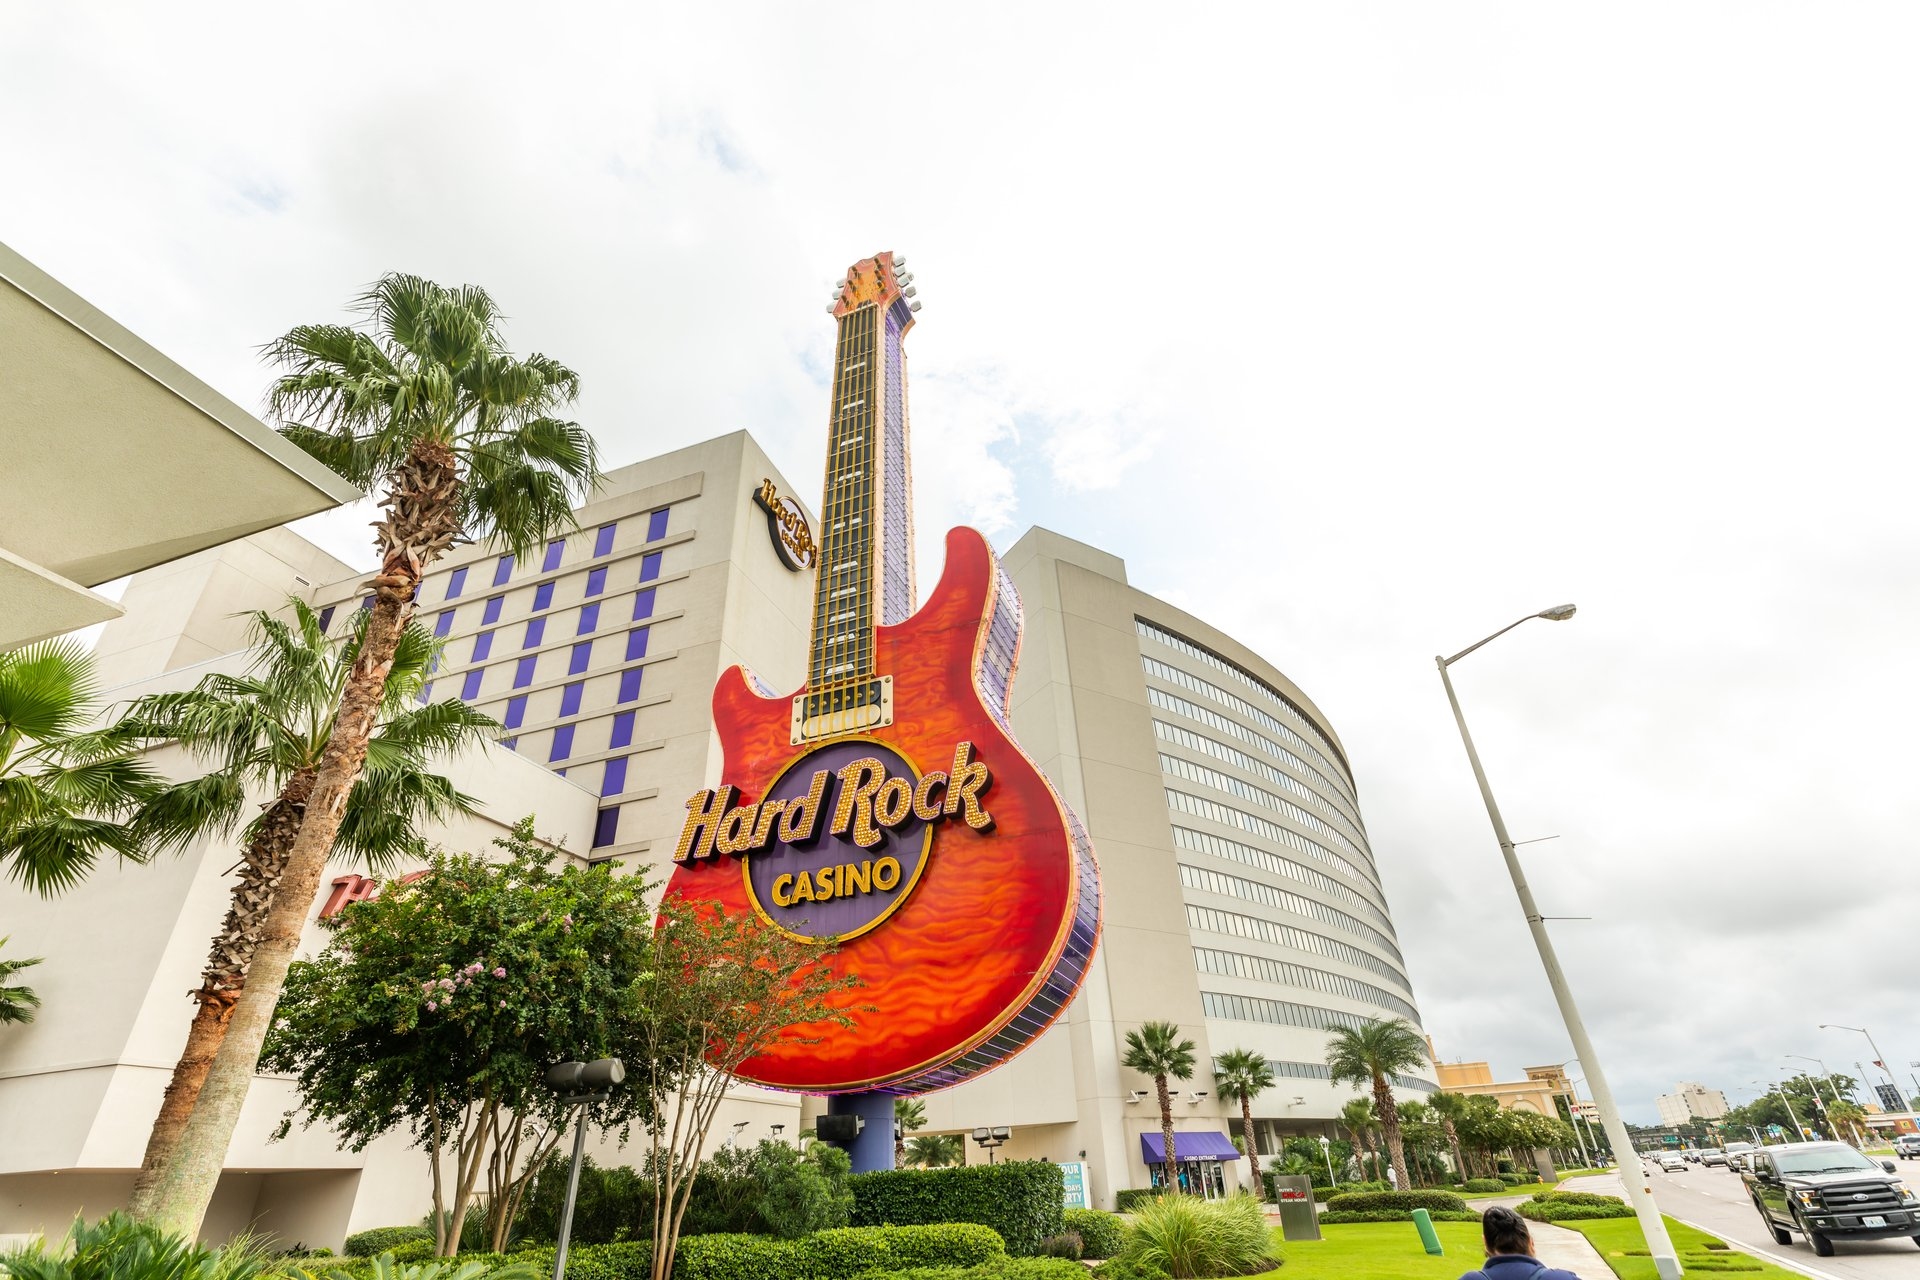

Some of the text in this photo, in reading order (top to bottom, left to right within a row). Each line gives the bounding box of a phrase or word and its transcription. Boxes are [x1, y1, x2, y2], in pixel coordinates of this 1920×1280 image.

[760, 478, 817, 559] Hard Roc
[672, 741, 993, 864] Hard Rock
[771, 856, 901, 908] CASINO
[1059, 1165, 1080, 1175] OUR
